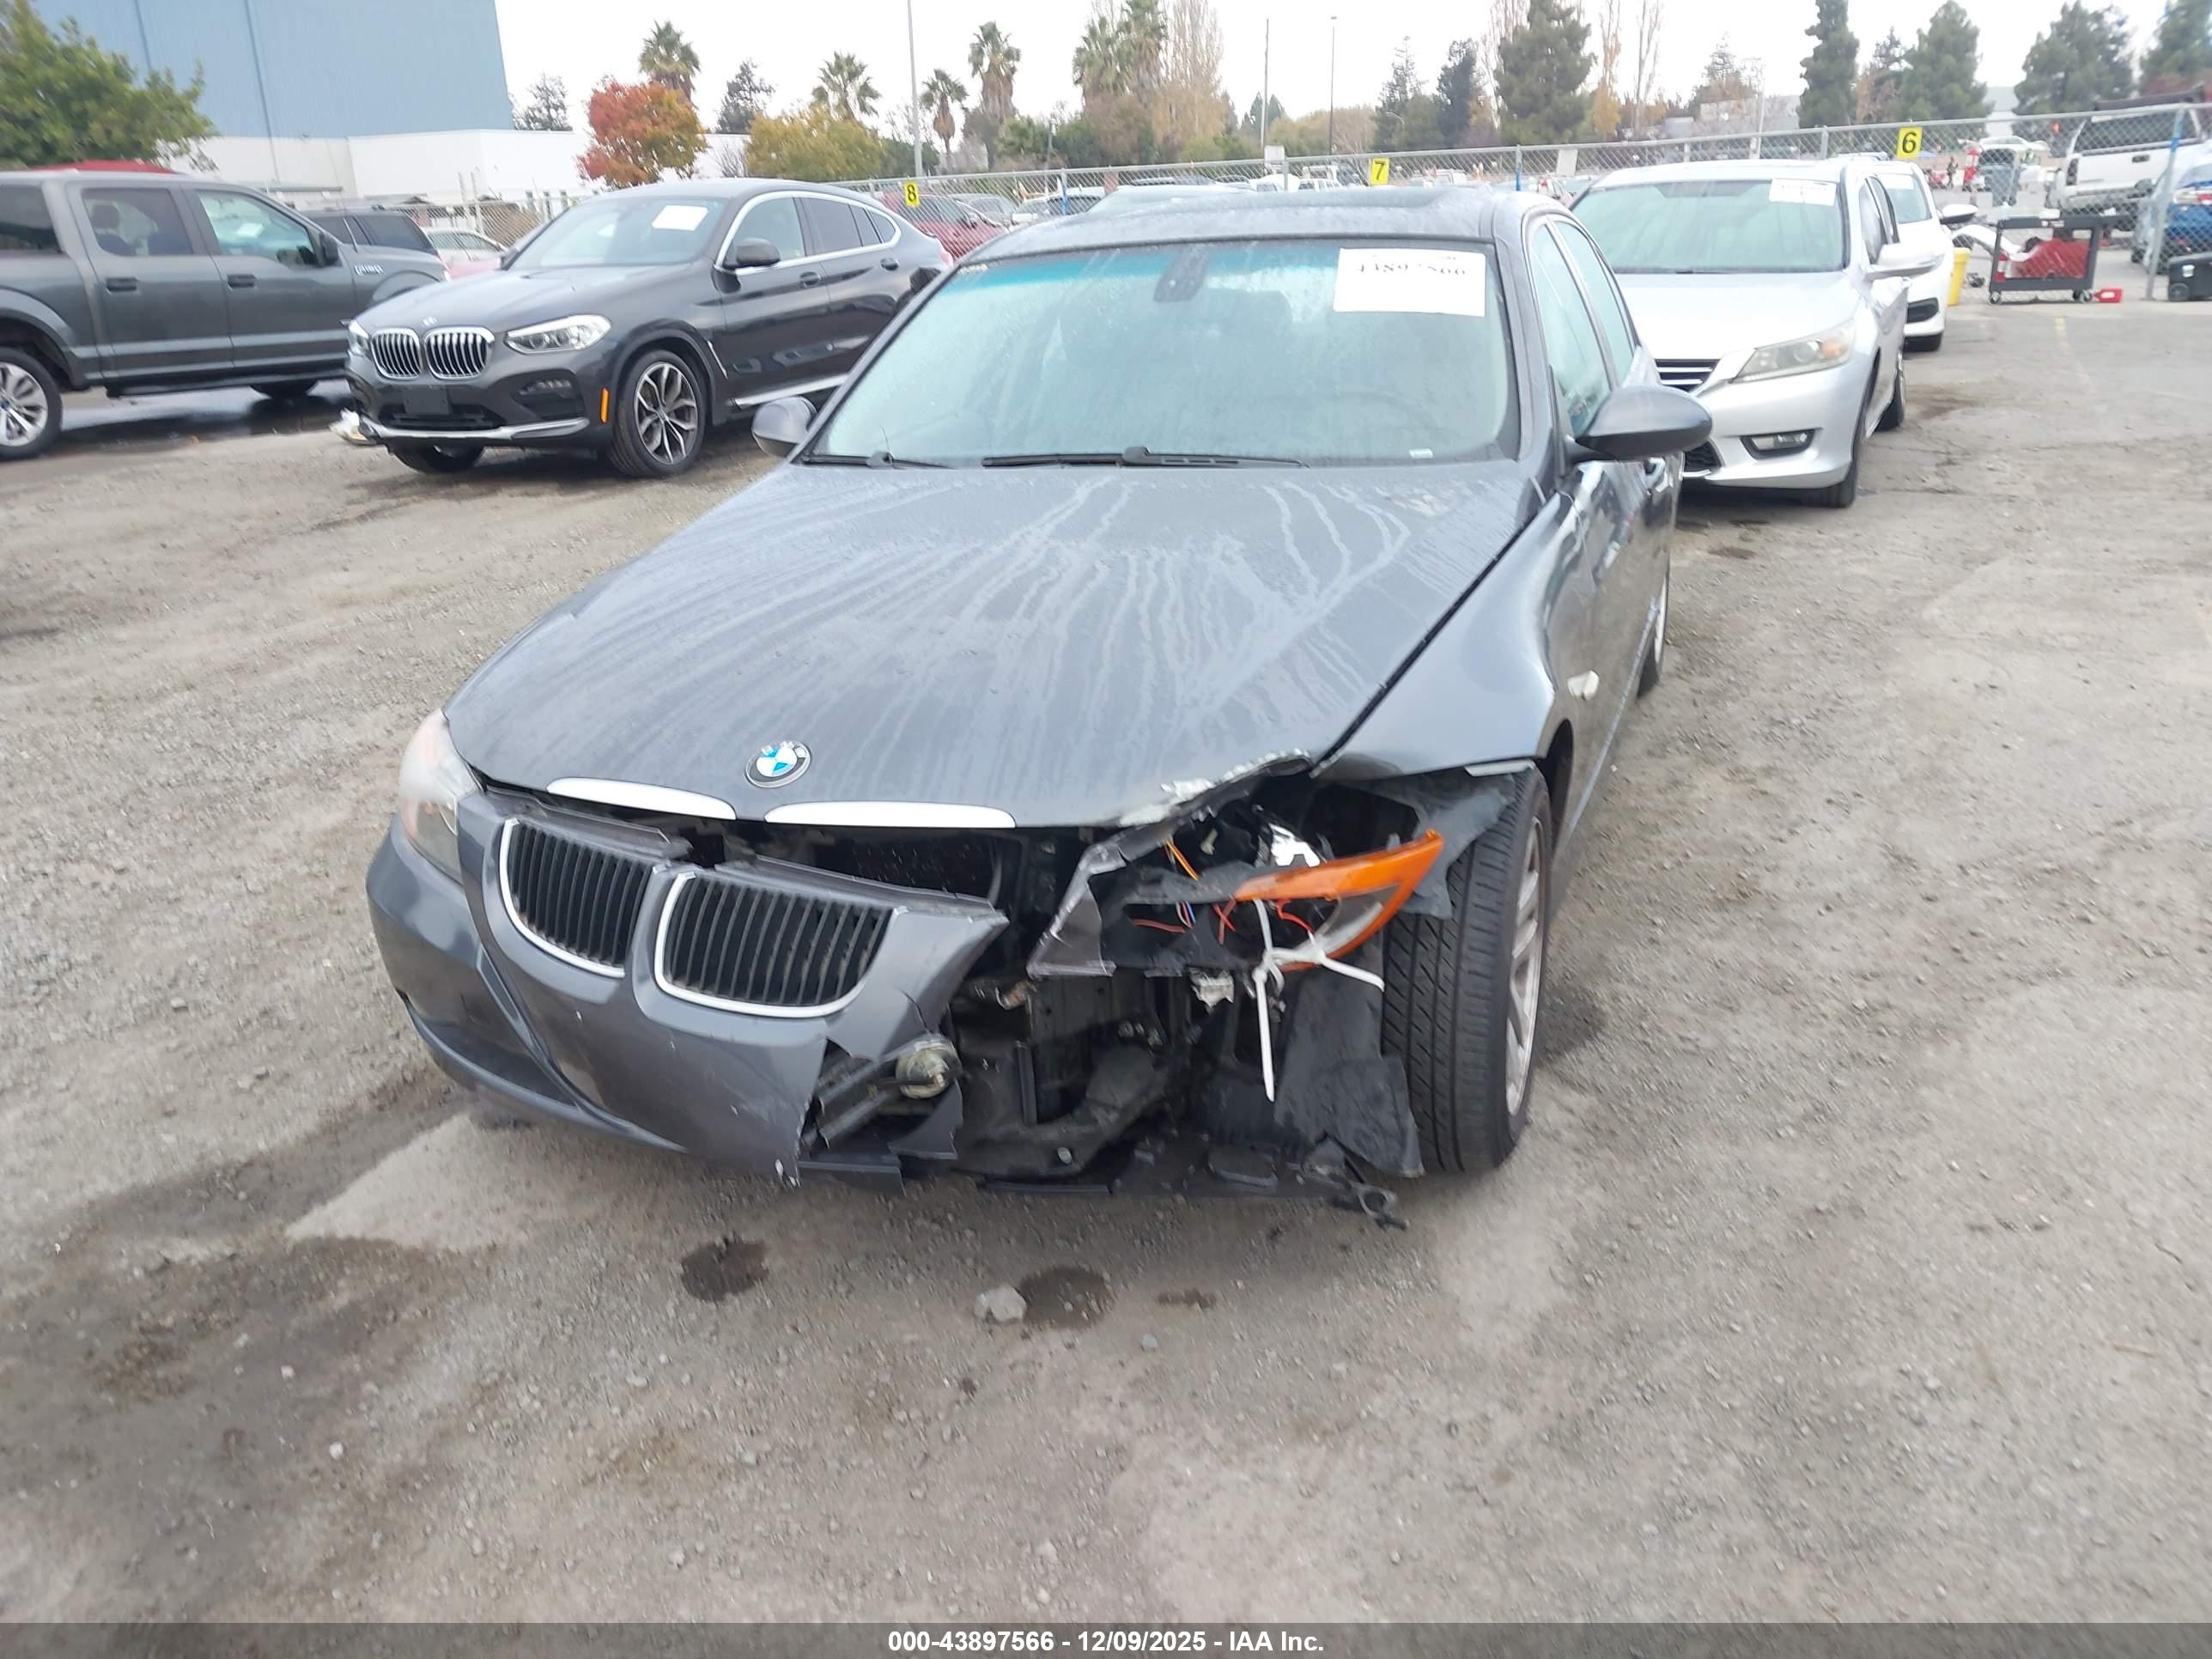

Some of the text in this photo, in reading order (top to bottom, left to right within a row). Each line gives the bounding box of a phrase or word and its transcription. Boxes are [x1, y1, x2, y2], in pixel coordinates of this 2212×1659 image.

[1902, 131, 1917, 154] 6
[1374, 161, 1386, 180] 7
[907, 183, 917, 202] 8
